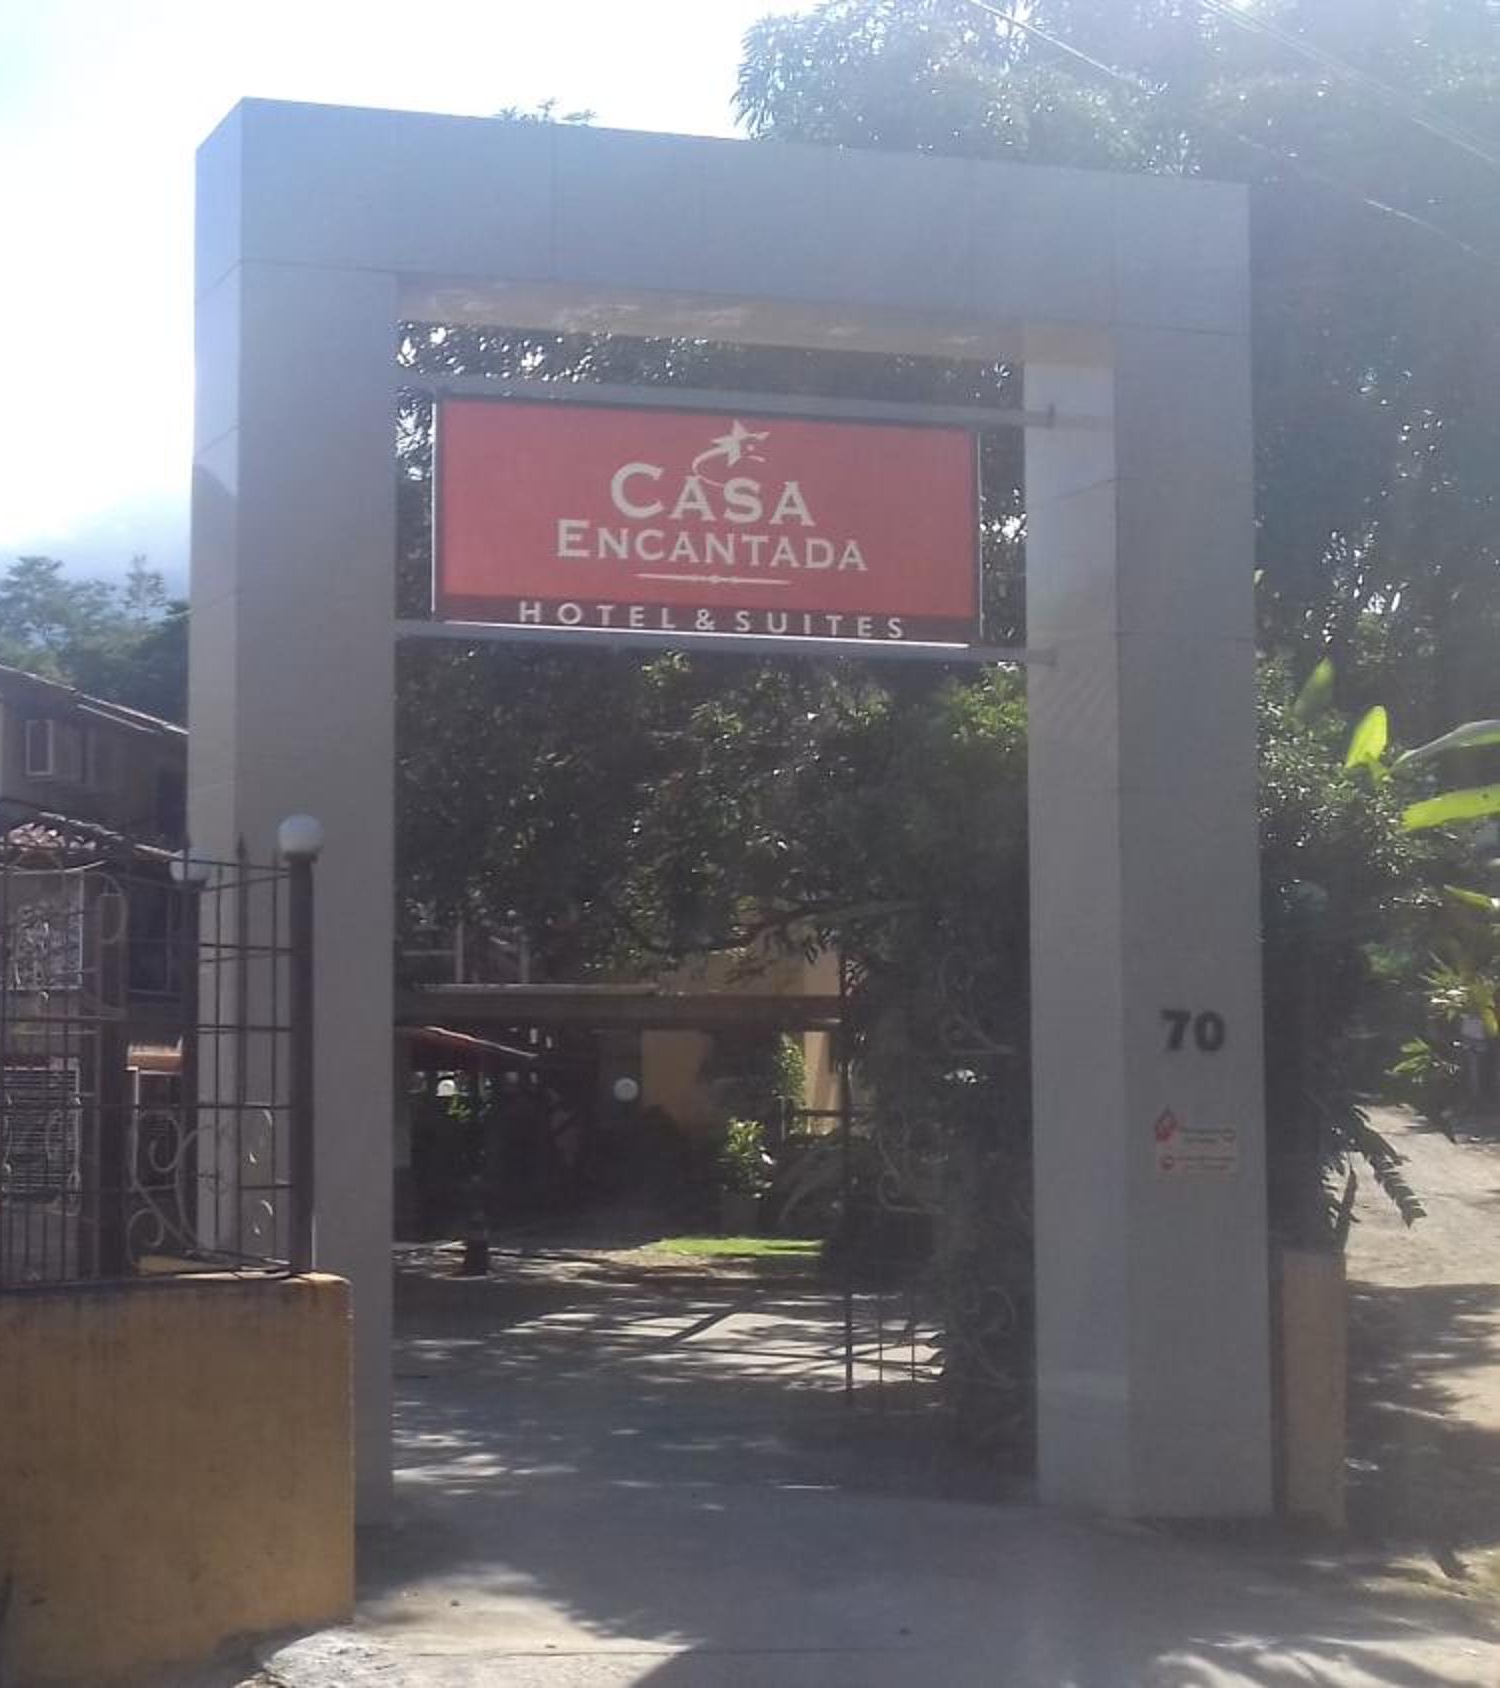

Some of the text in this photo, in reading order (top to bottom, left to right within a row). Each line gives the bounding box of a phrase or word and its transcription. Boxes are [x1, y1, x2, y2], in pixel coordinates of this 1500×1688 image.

[610, 461, 816, 527] CASA
[556, 518, 869, 572] ENCANTADA
[1160, 1008, 1226, 1052] 70
